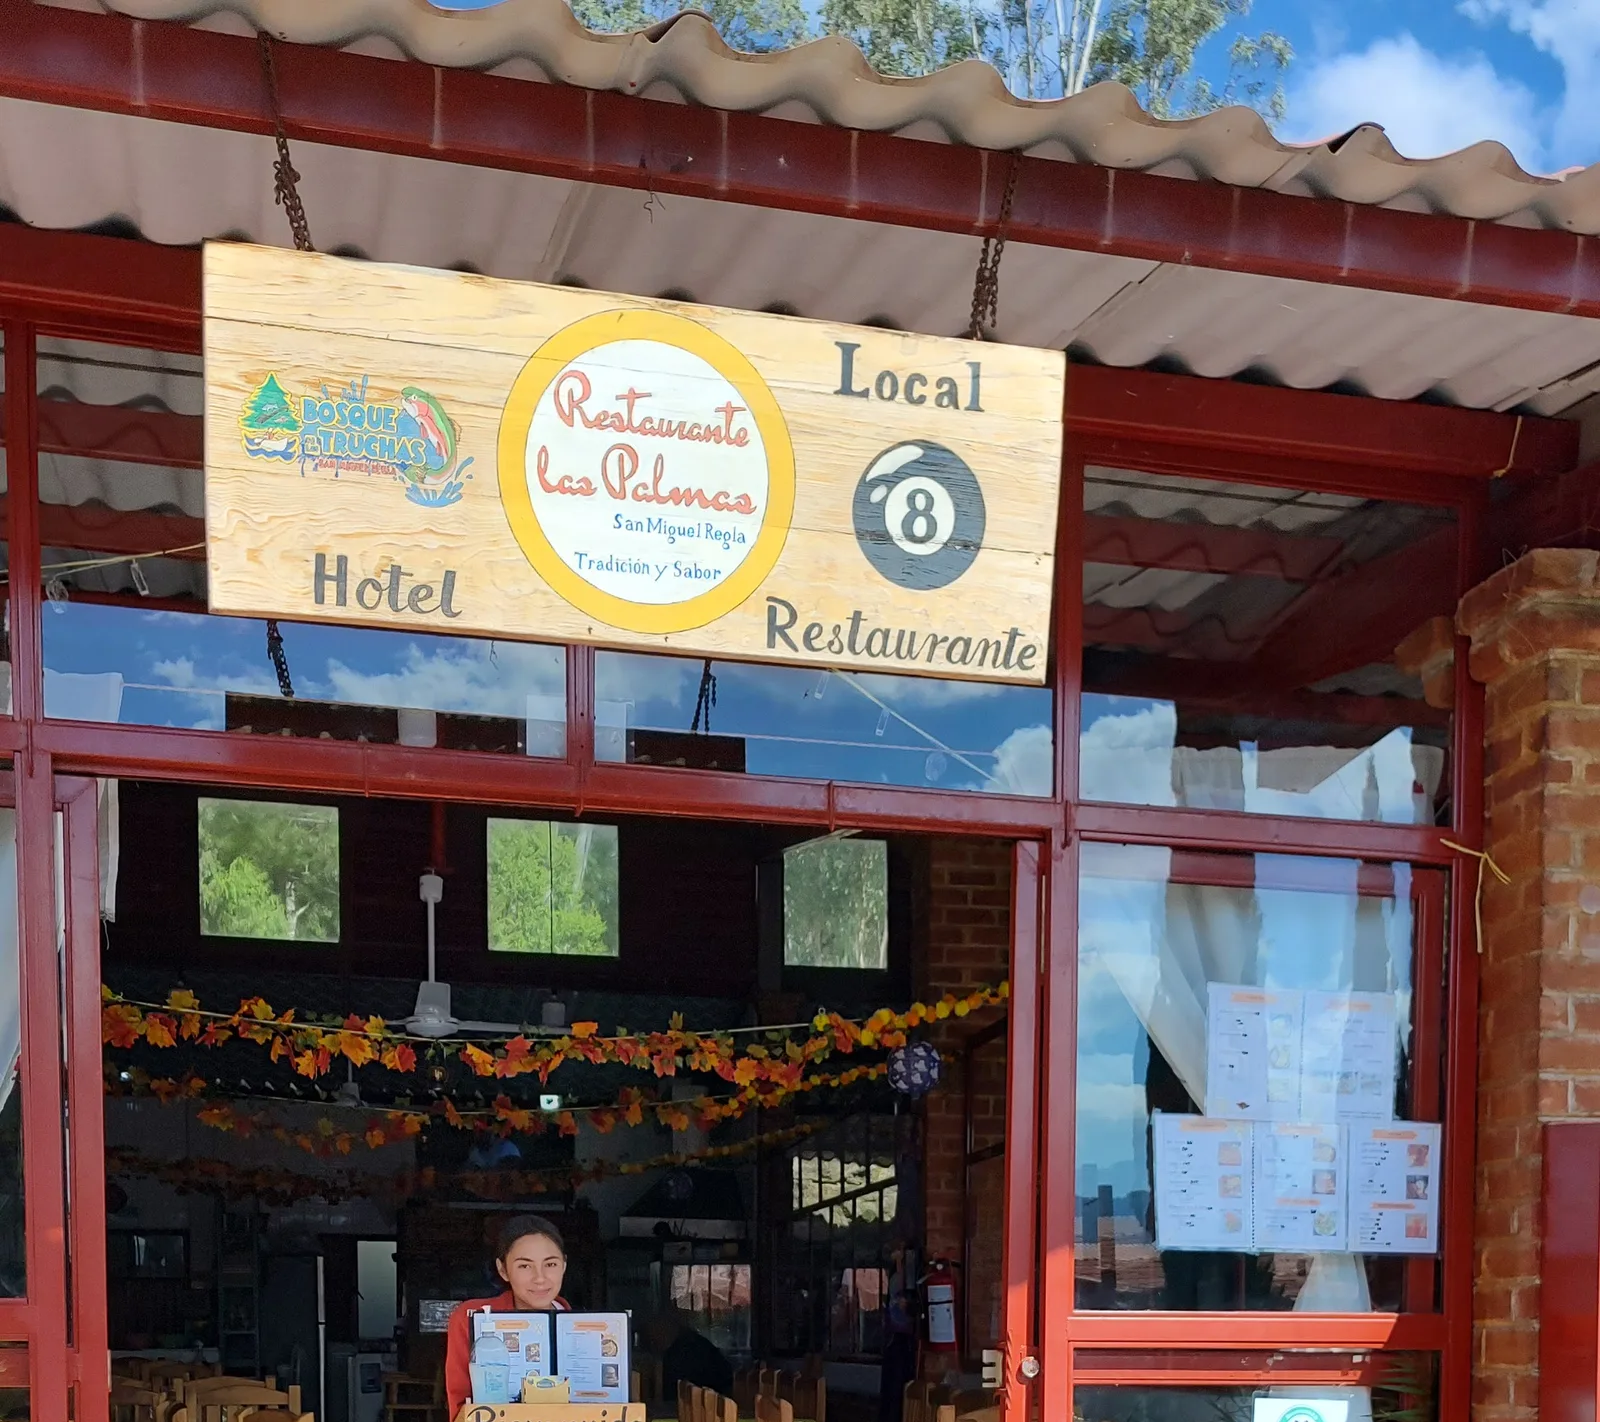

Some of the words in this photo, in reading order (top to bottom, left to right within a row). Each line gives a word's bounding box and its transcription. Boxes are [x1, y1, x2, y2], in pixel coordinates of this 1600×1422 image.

[834, 341, 985, 412] Local
[301, 397, 397, 432] BOSQUE
[553, 369, 750, 448] Restaurante
[319, 430, 427, 466] TRUCHAS
[601, 443, 757, 515] Palmas
[613, 513, 644, 532] San
[647, 517, 701, 544] Miguel
[705, 523, 746, 549] Regla
[901, 488, 938, 544] 8
[313, 553, 463, 618] Hotel
[574, 552, 650, 575] Tradición
[654, 565, 668, 581] y
[673, 561, 721, 580] Sabor
[766, 596, 1037, 671] Restaurante
